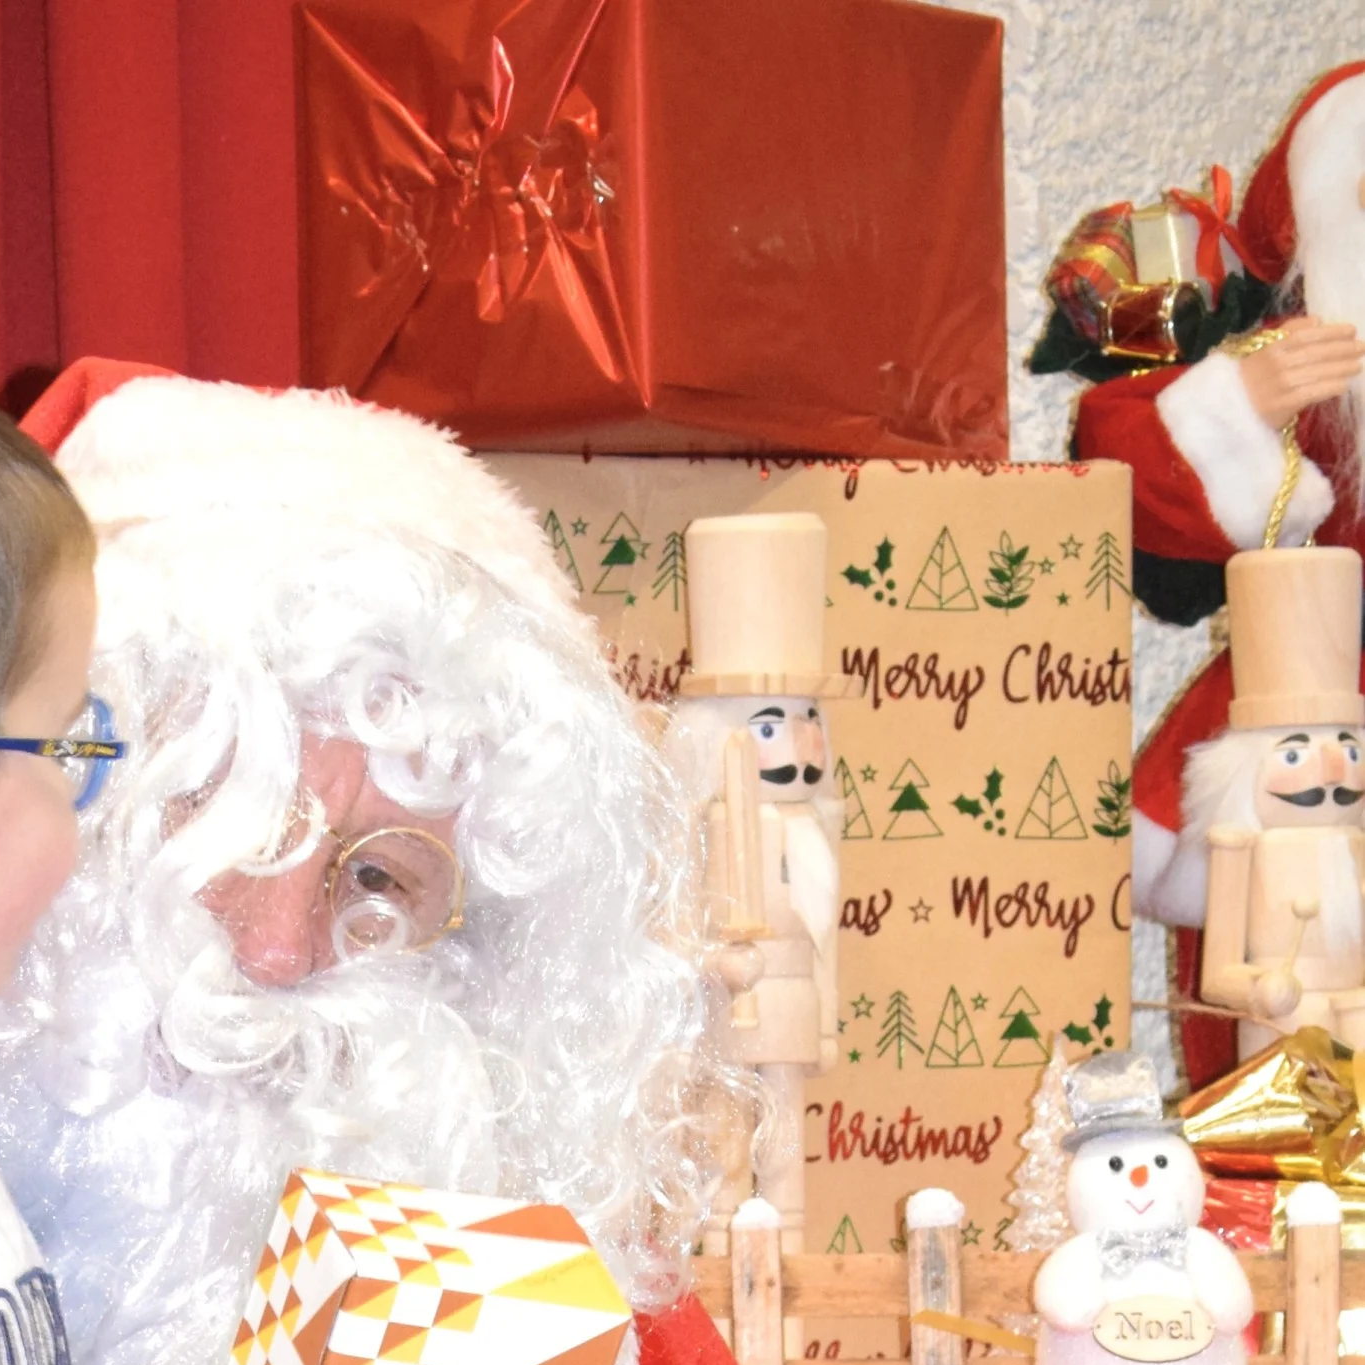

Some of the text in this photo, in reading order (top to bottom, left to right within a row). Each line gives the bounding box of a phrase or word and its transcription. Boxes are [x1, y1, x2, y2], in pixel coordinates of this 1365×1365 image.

[841, 646, 986, 731] Merry
[951, 875, 1096, 959] Merry
[1114, 1310, 1196, 1341] Noel
